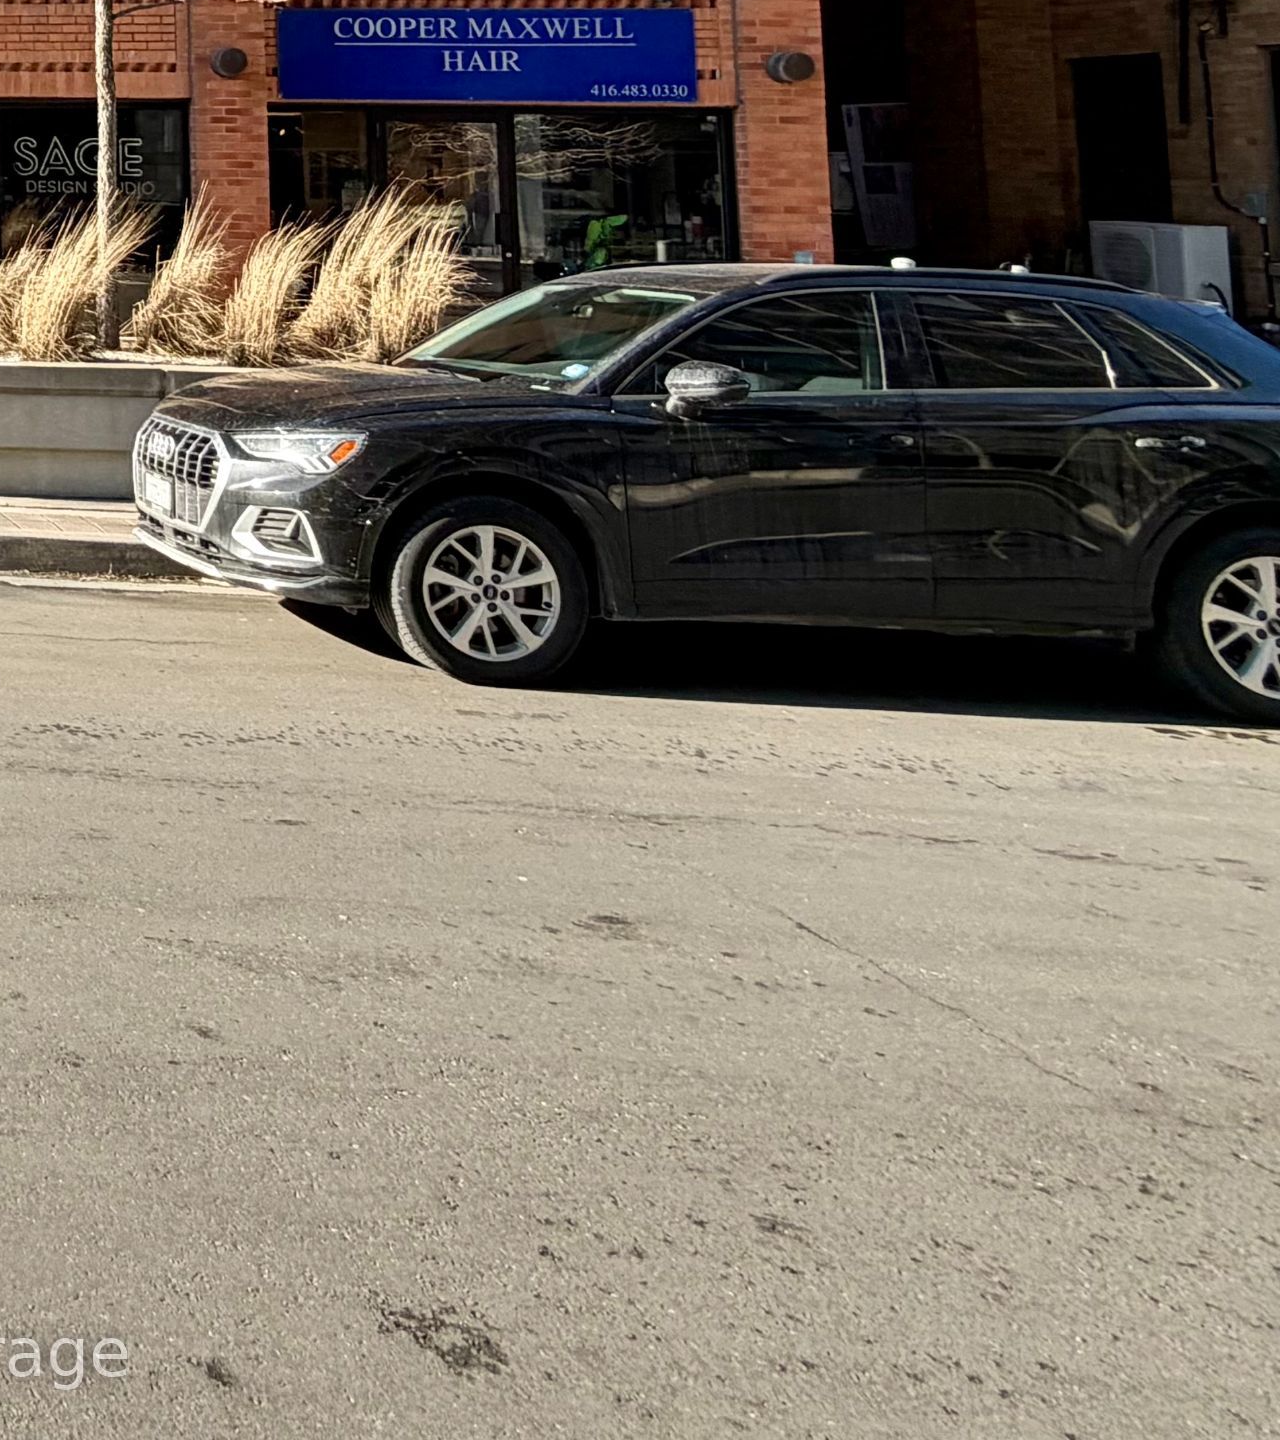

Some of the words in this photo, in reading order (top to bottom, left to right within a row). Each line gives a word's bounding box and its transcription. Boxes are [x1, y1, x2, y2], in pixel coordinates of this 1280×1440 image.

[333, 17, 458, 39] COOPER
[467, 17, 634, 39] MAXWELL
[442, 50, 521, 72] HAIR
[590, 84, 689, 98] 416.483.0330
[14, 136, 143, 176] SAGE
[25, 180, 87, 193] DESIGN
